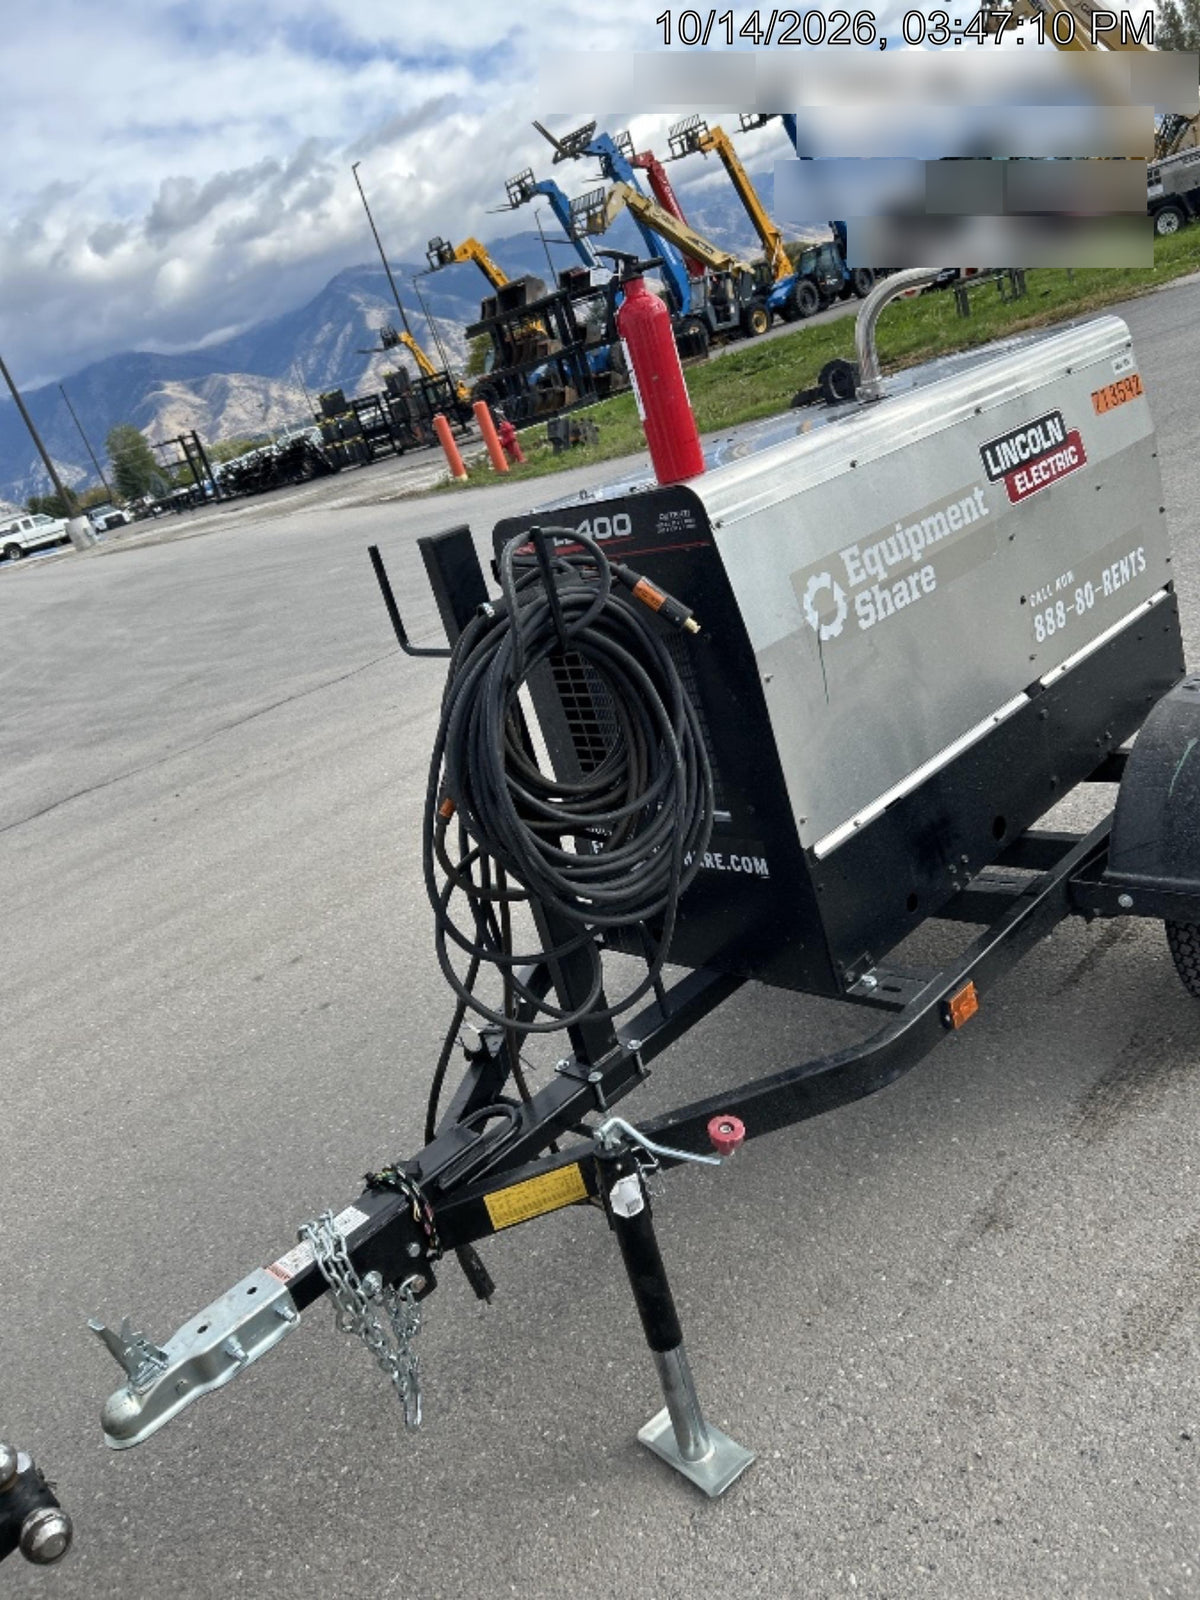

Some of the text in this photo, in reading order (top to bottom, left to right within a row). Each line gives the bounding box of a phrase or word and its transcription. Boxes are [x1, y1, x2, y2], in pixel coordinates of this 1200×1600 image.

[985, 417, 1065, 475] LINCOLN
[1014, 445, 1079, 494] ELECTRIC
[839, 486, 989, 586] Equipment
[854, 564, 937, 630] Share
[1030, 585, 1054, 607] CALL
[1033, 547, 1147, 643] 888-80-RENTS
